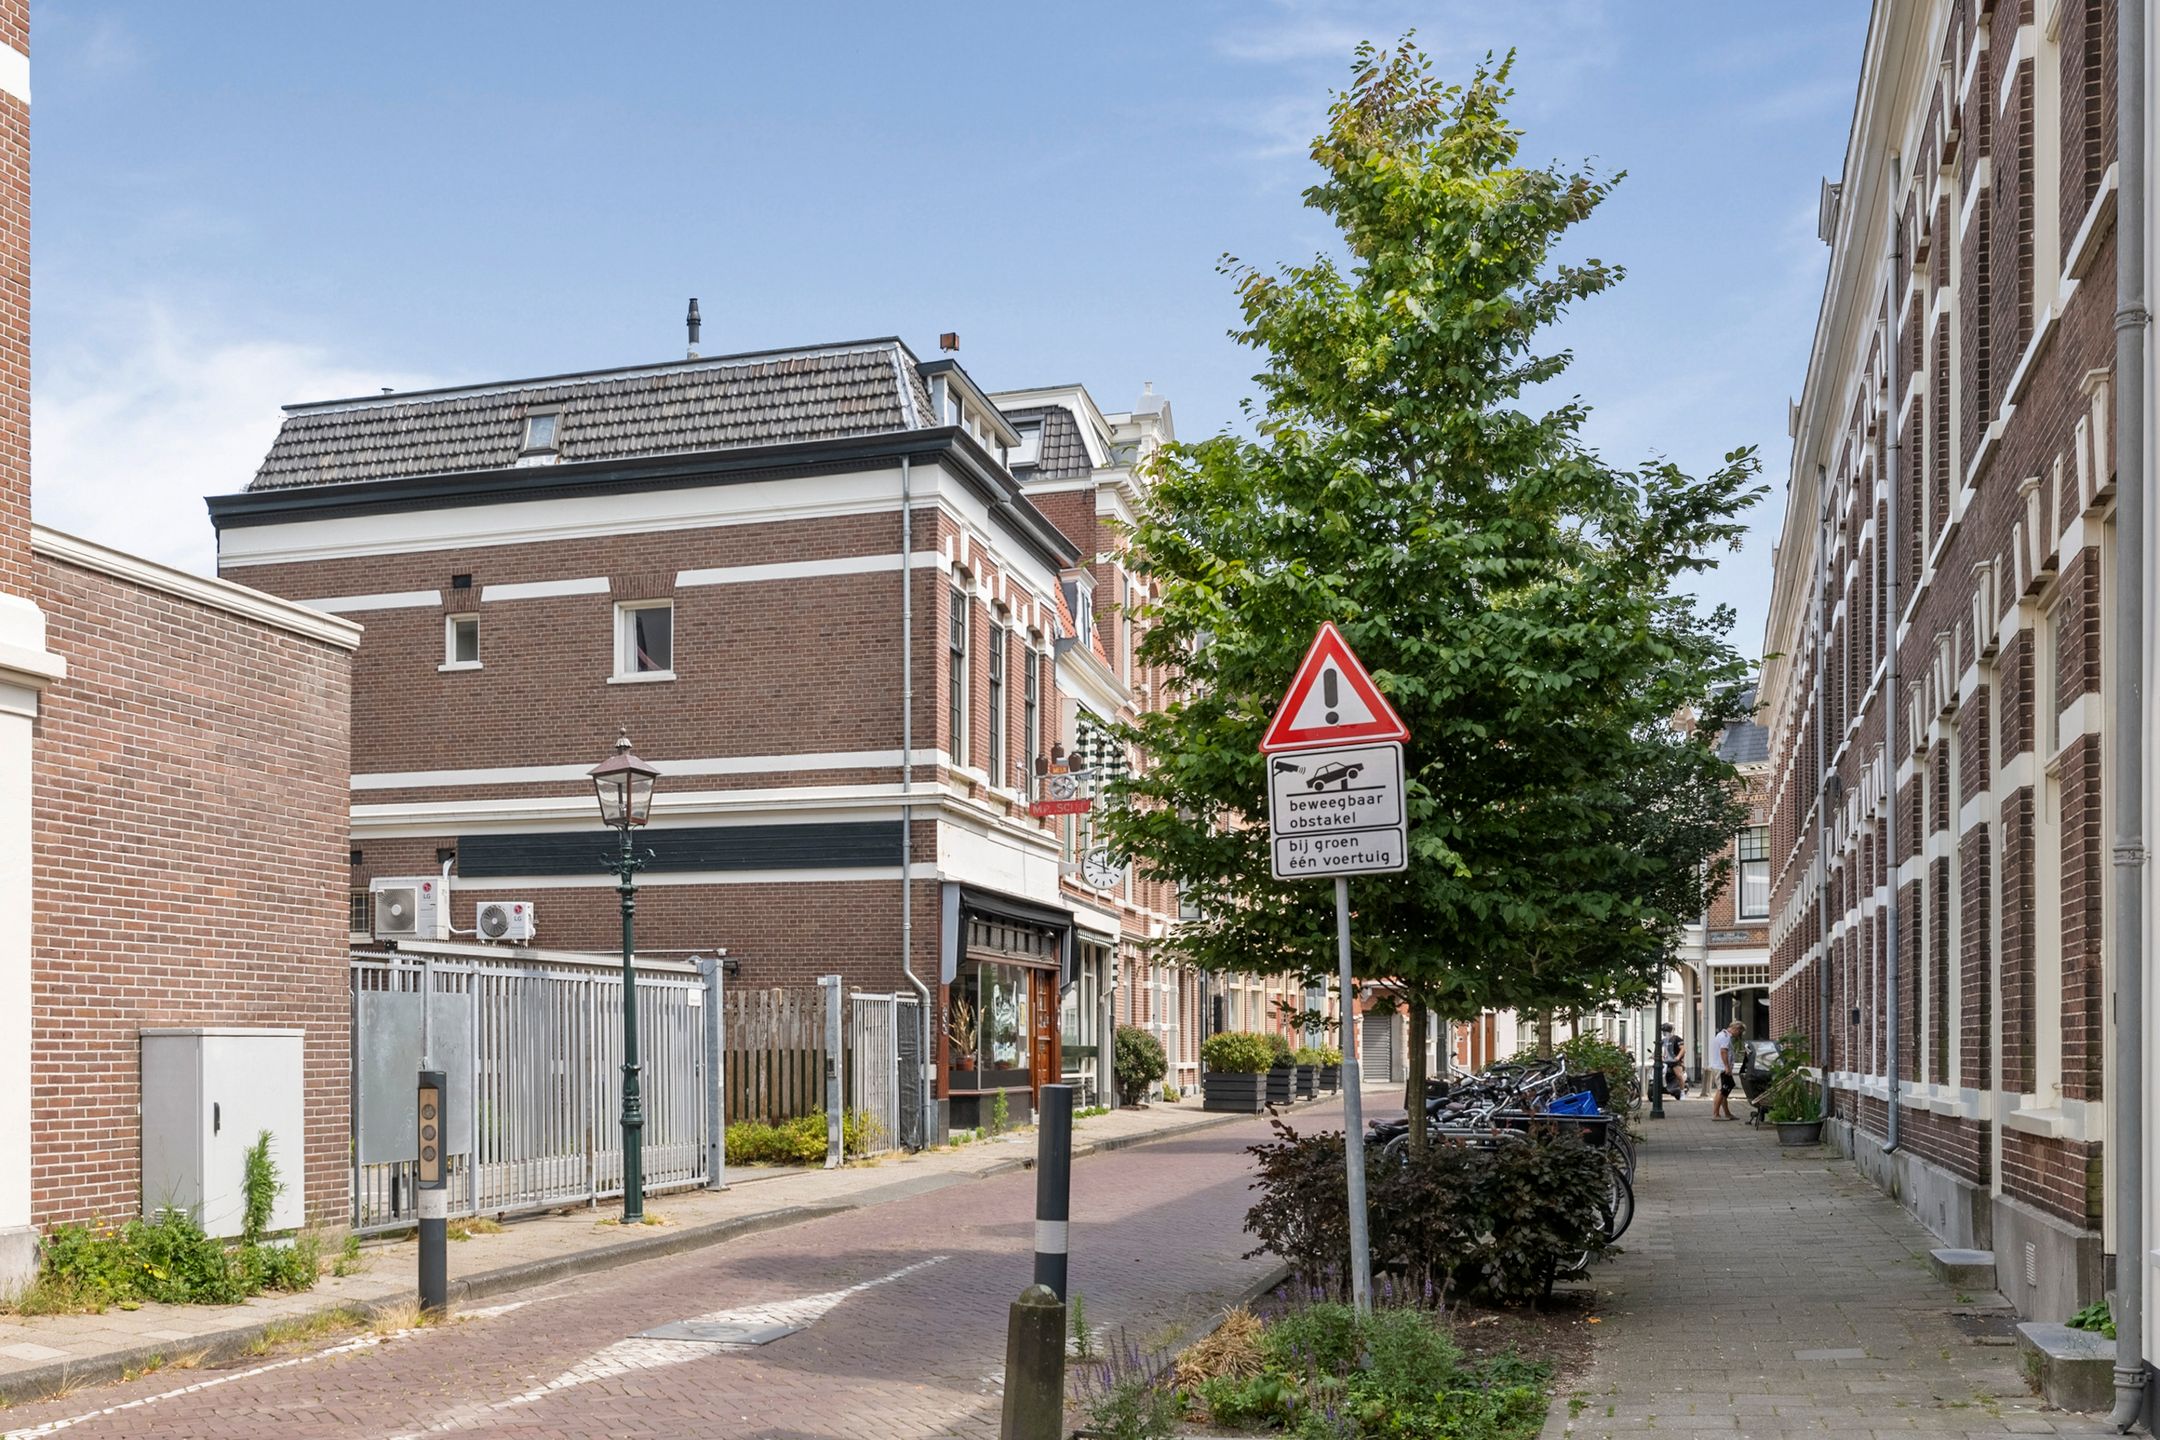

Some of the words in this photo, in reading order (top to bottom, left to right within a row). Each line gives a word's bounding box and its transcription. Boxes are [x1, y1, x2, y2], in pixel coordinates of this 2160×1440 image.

[1290, 795, 1383, 811] beweegbaar
[1290, 812, 1356, 828] obstakel
[1289, 839, 1308, 854] bij
[1315, 837, 1359, 853] groen
[1290, 855, 1317, 868] één
[1323, 850, 1390, 865] voertuig
